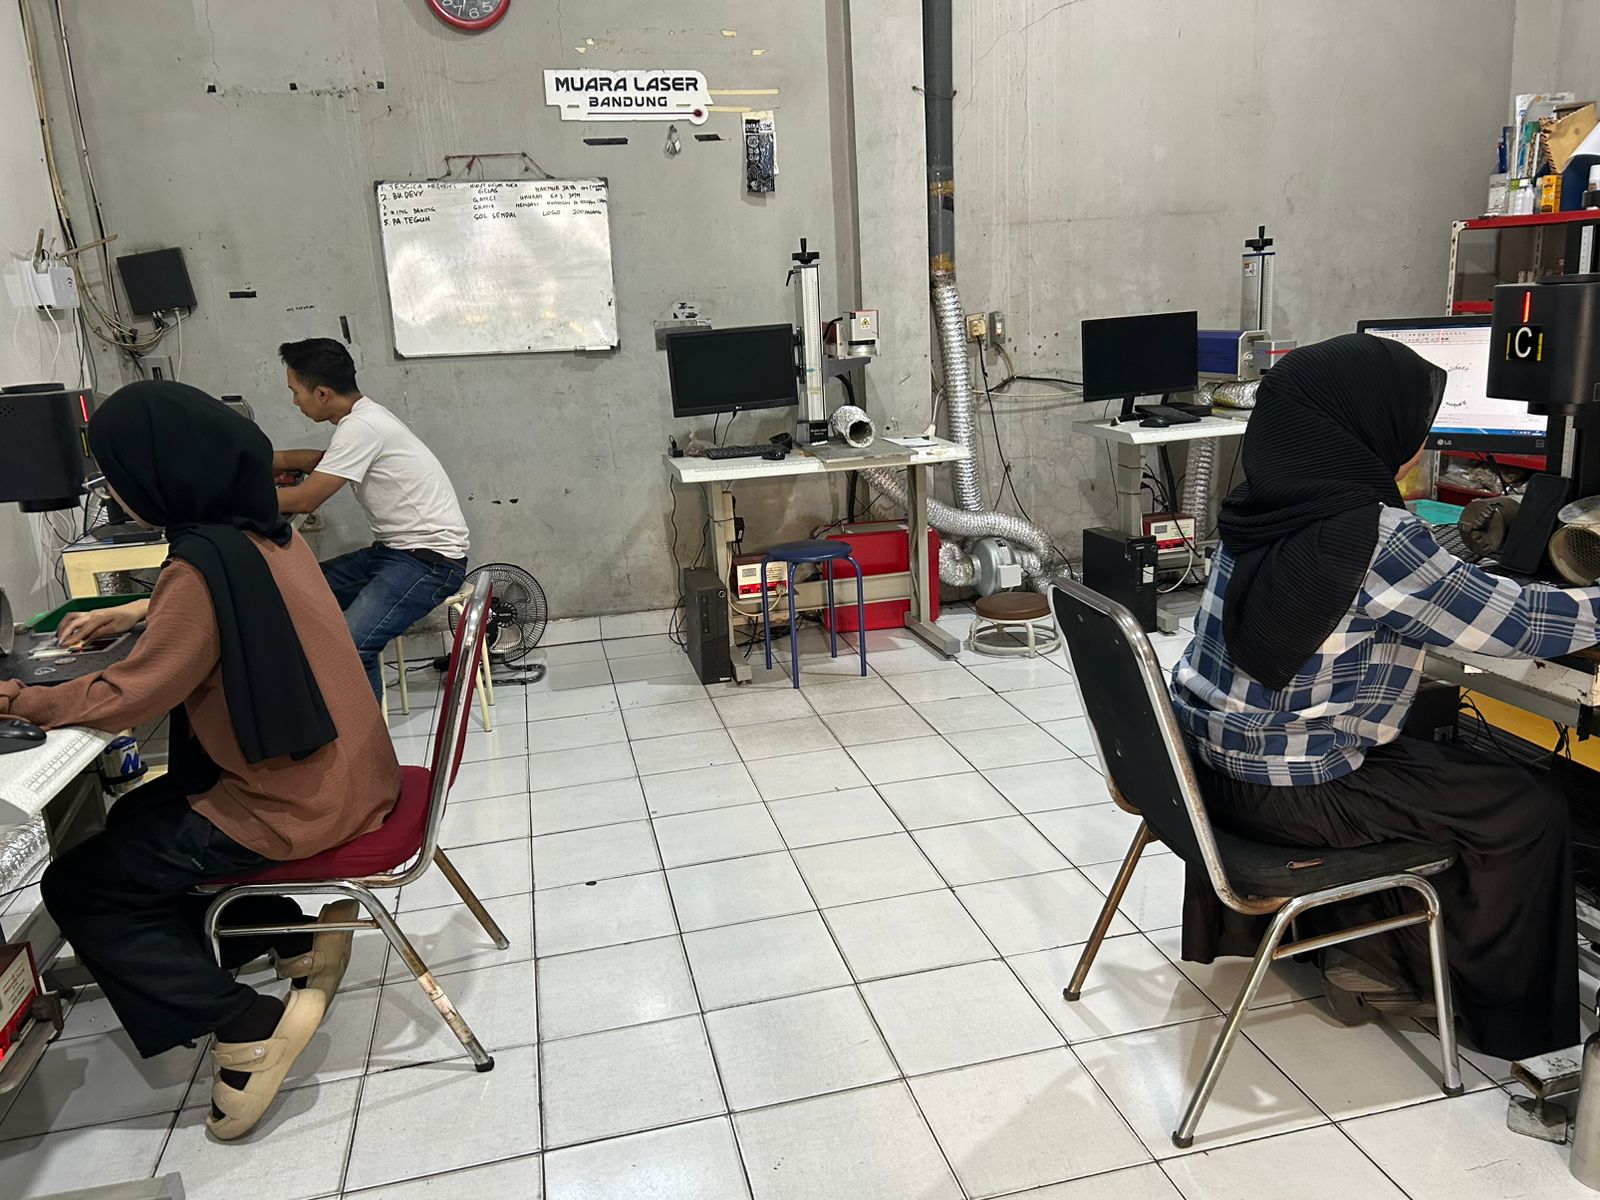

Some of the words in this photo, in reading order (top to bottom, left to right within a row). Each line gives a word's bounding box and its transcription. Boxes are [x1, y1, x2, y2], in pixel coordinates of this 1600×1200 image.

[453, 4, 463, 16] 7
[468, 7, 480, 19] 6
[482, 1, 493, 13] 5
[555, 76, 627, 92] MUARA
[633, 76, 699, 92] LASER
[588, 96, 668, 108] BANDUNG
[1514, 326, 1533, 358] C
